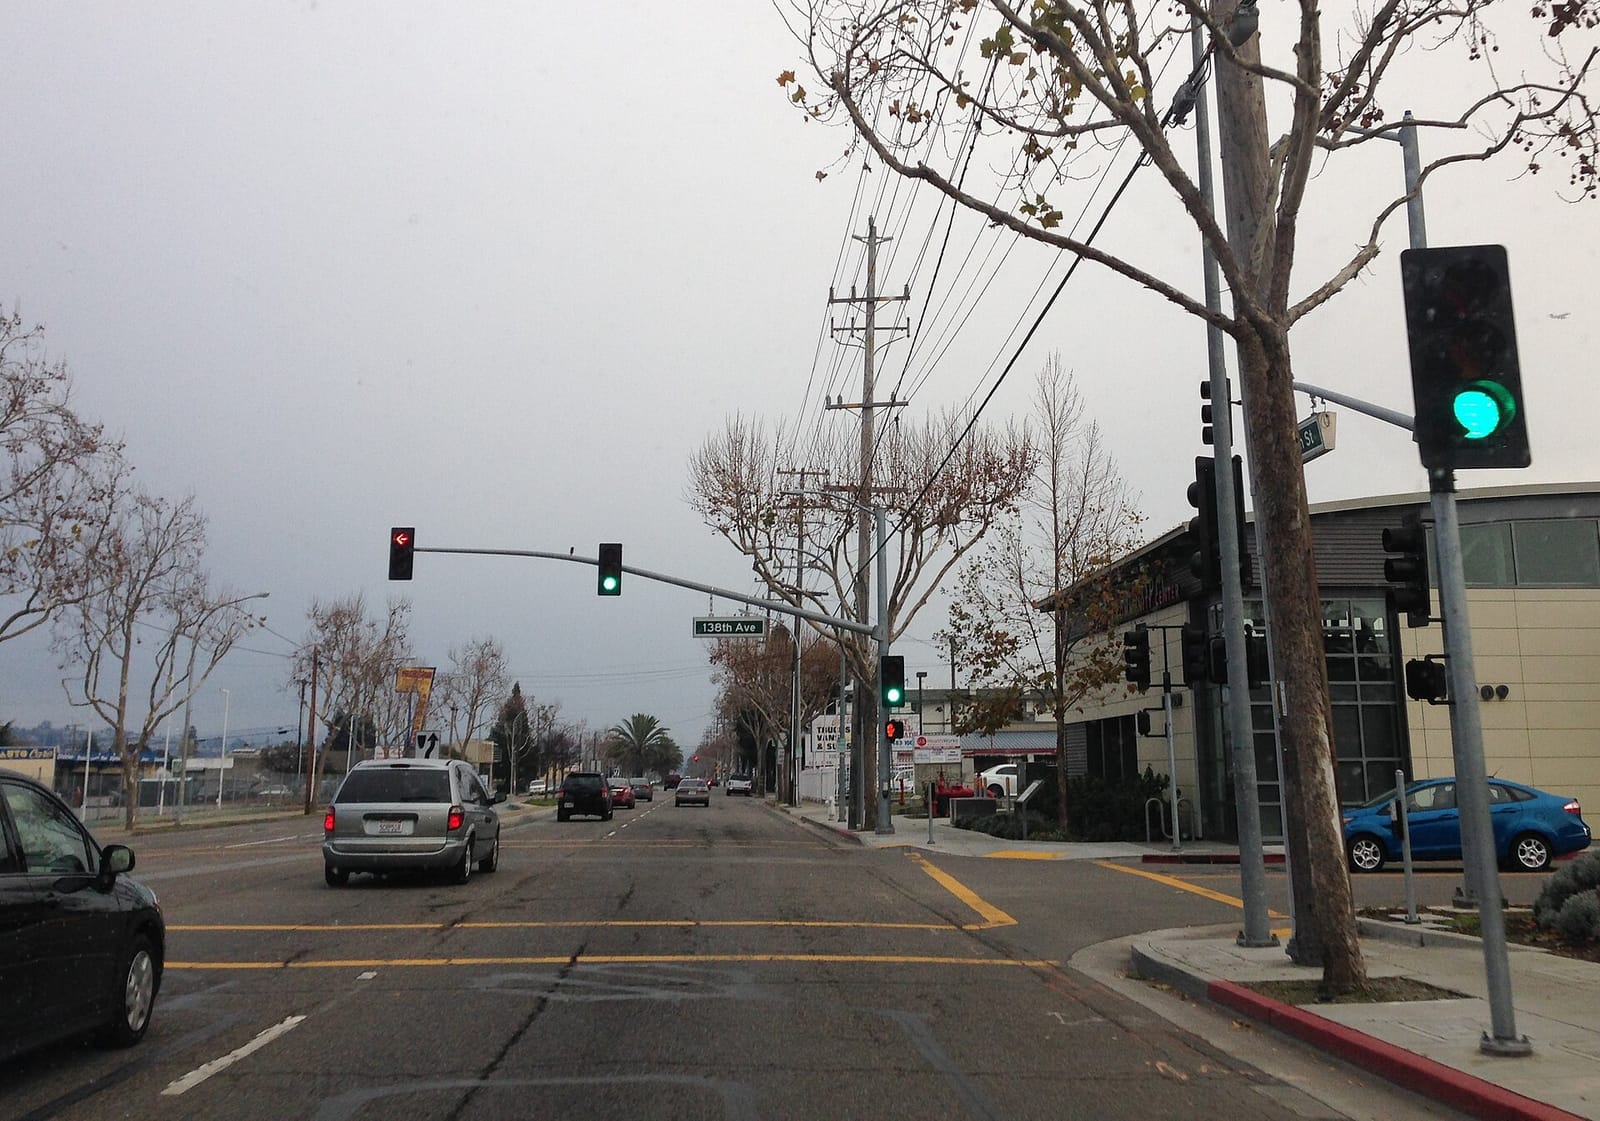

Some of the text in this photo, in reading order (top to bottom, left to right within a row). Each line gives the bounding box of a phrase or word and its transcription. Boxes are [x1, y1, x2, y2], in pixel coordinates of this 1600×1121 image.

[1303, 429, 1314, 447] St
[702, 622, 756, 633] 138th Ave
